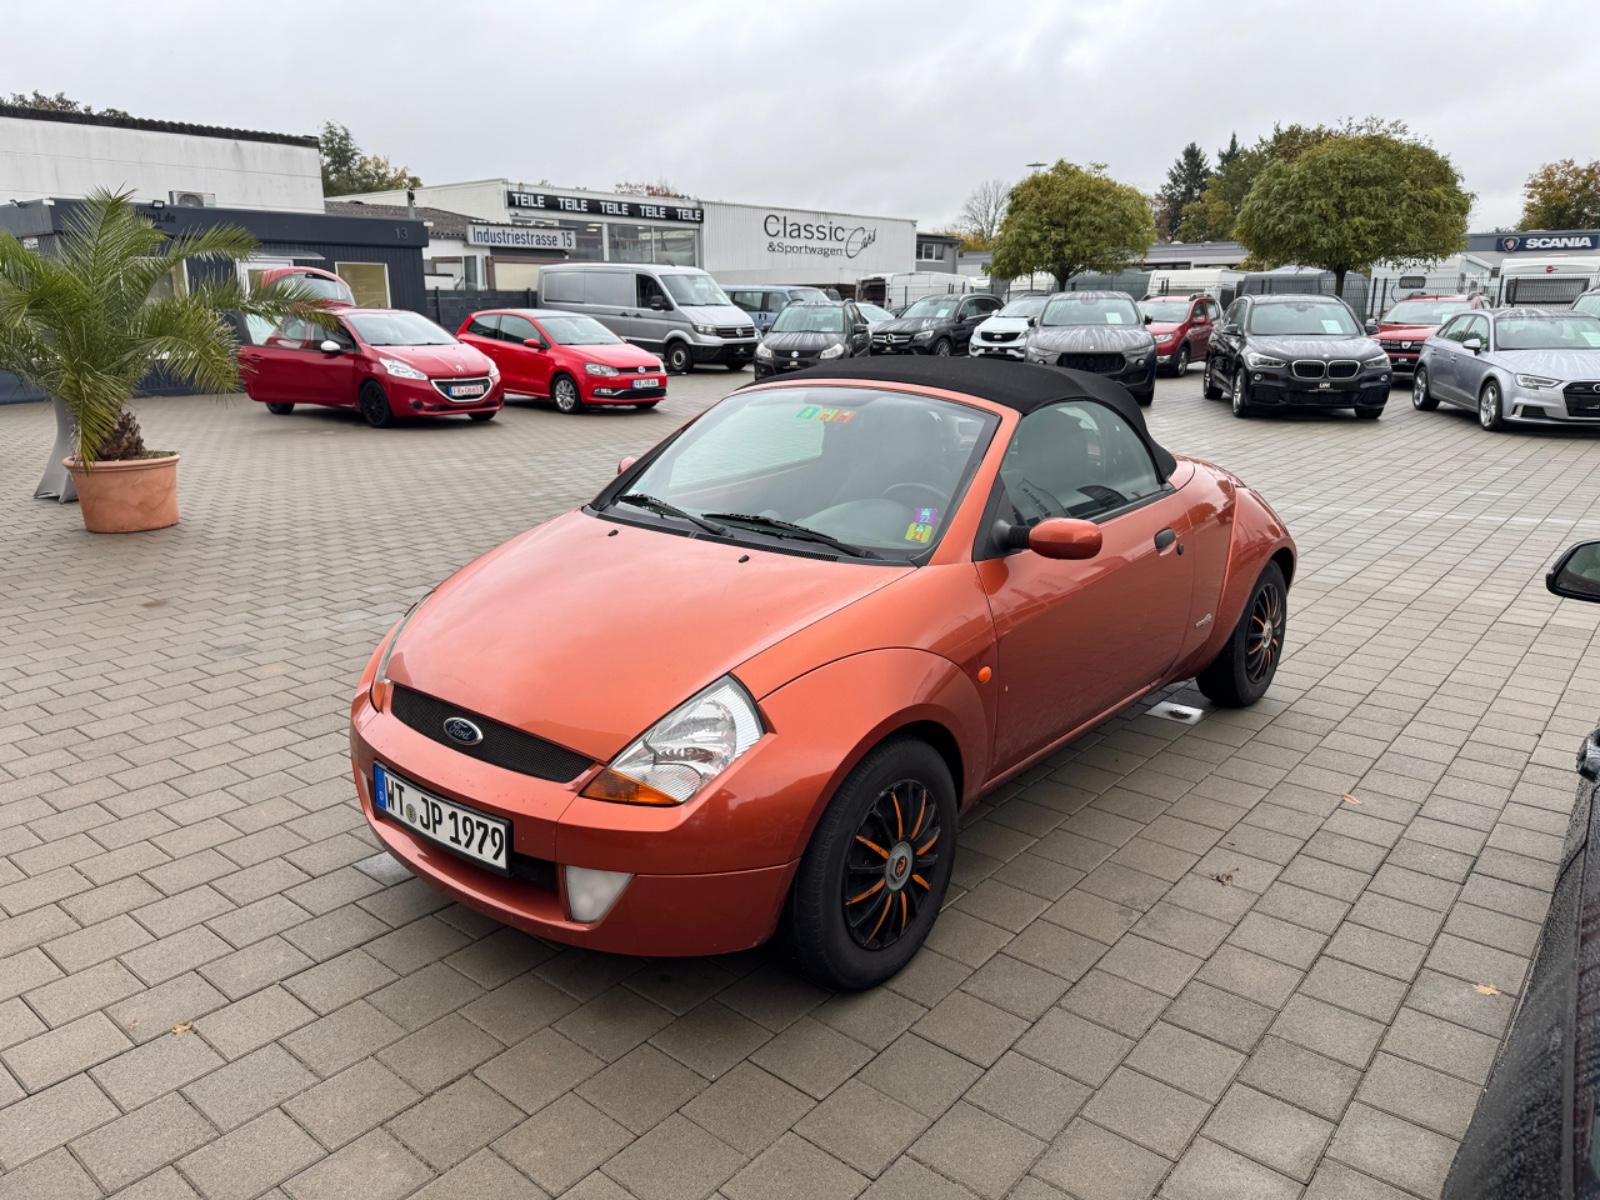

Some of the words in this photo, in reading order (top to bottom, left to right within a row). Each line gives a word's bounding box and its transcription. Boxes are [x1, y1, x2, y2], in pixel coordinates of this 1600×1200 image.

[512, 193, 545, 208] TEILE
[557, 197, 589, 212] TEILE
[599, 201, 629, 216] TEILE
[639, 205, 667, 219] TEILE
[675, 208, 702, 221] TEILE
[394, 226, 409, 240] 13
[472, 226, 558, 247] Industriestrasse
[561, 231, 573, 247] 15
[763, 214, 845, 242] Classic
[767, 241, 844, 258] &Sportwagen
[1525, 236, 1592, 249] SCANIA
[449, 720, 474, 740] Ford
[385, 776, 405, 817] WT
[419, 797, 443, 834] JP
[448, 811, 505, 861] 1979
